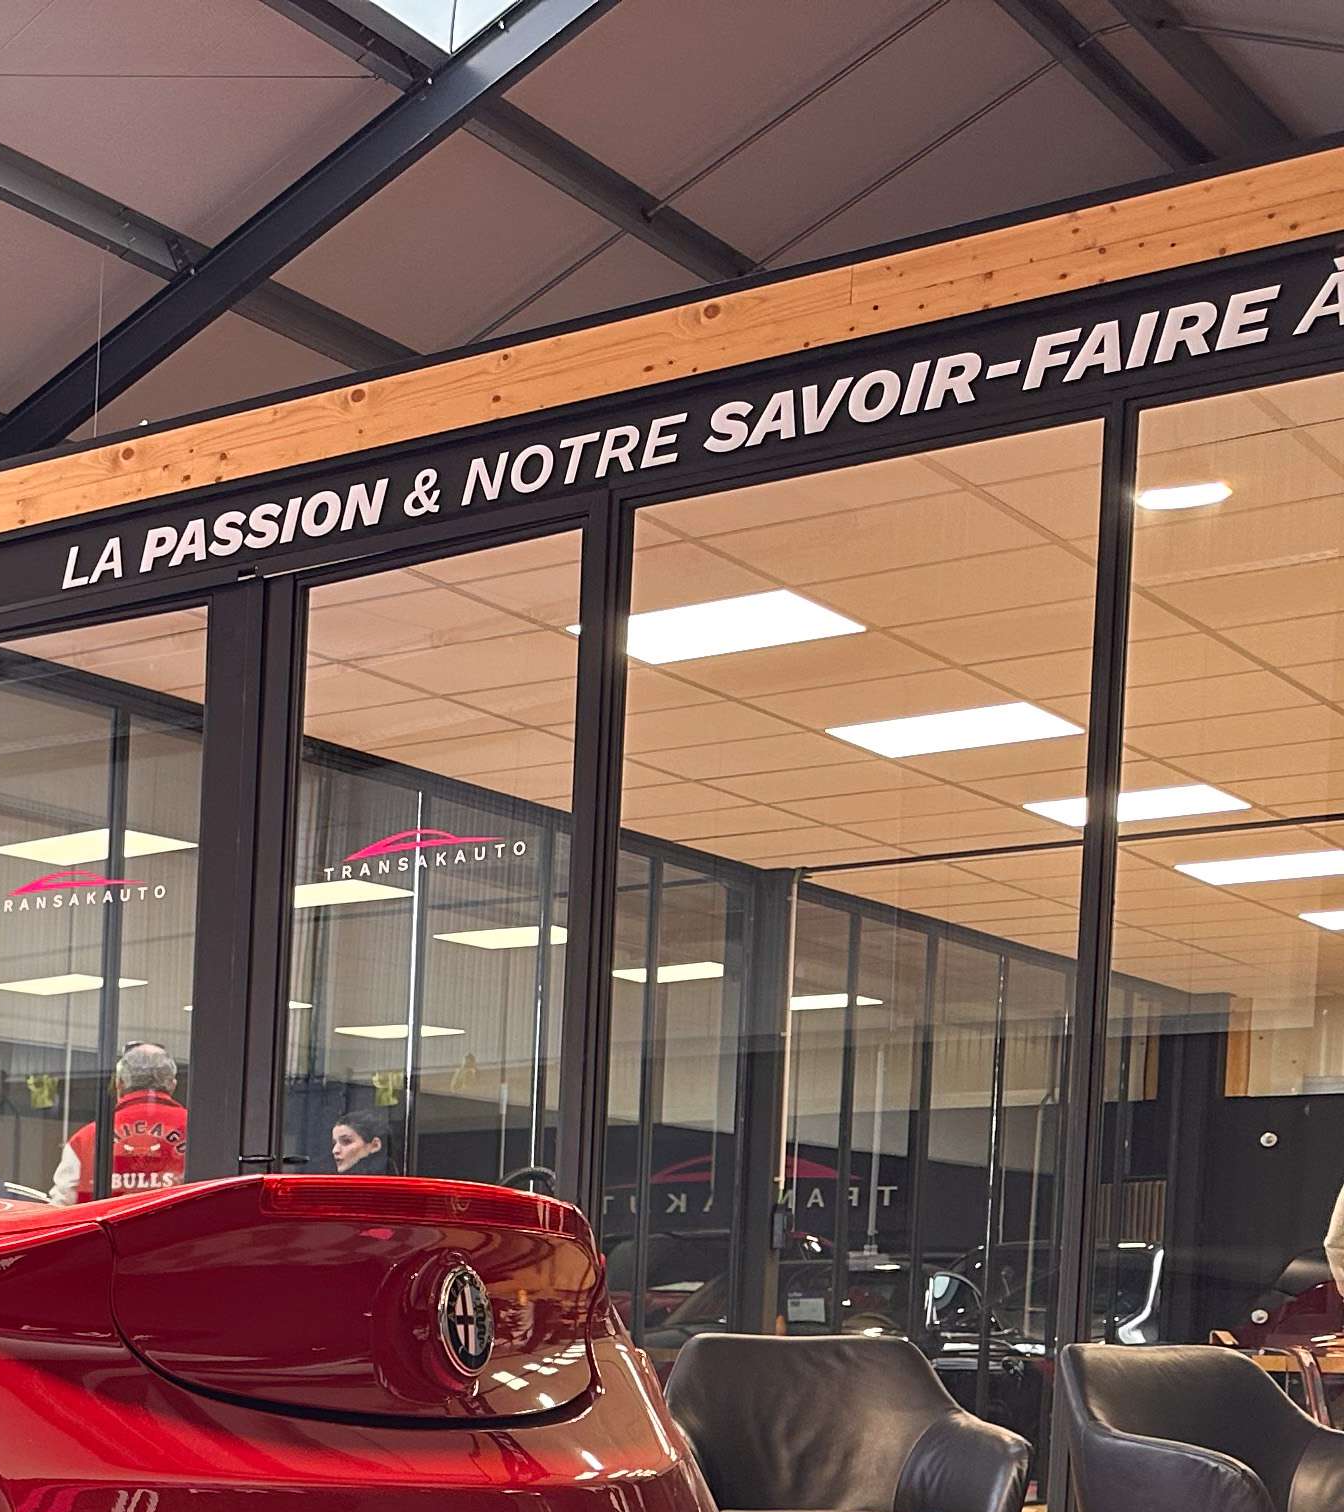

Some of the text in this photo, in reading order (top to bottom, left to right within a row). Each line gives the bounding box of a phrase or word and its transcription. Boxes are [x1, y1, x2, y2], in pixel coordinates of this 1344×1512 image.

[62, 537, 124, 589] LA
[139, 478, 389, 574] PASSION
[403, 467, 441, 519] &
[462, 411, 688, 506] NOTRE
[703, 283, 1282, 454] SAVOIR-FAIRE
[323, 840, 527, 882] TRANSAKAUTO
[112, 1172, 174, 1189] BULLS
